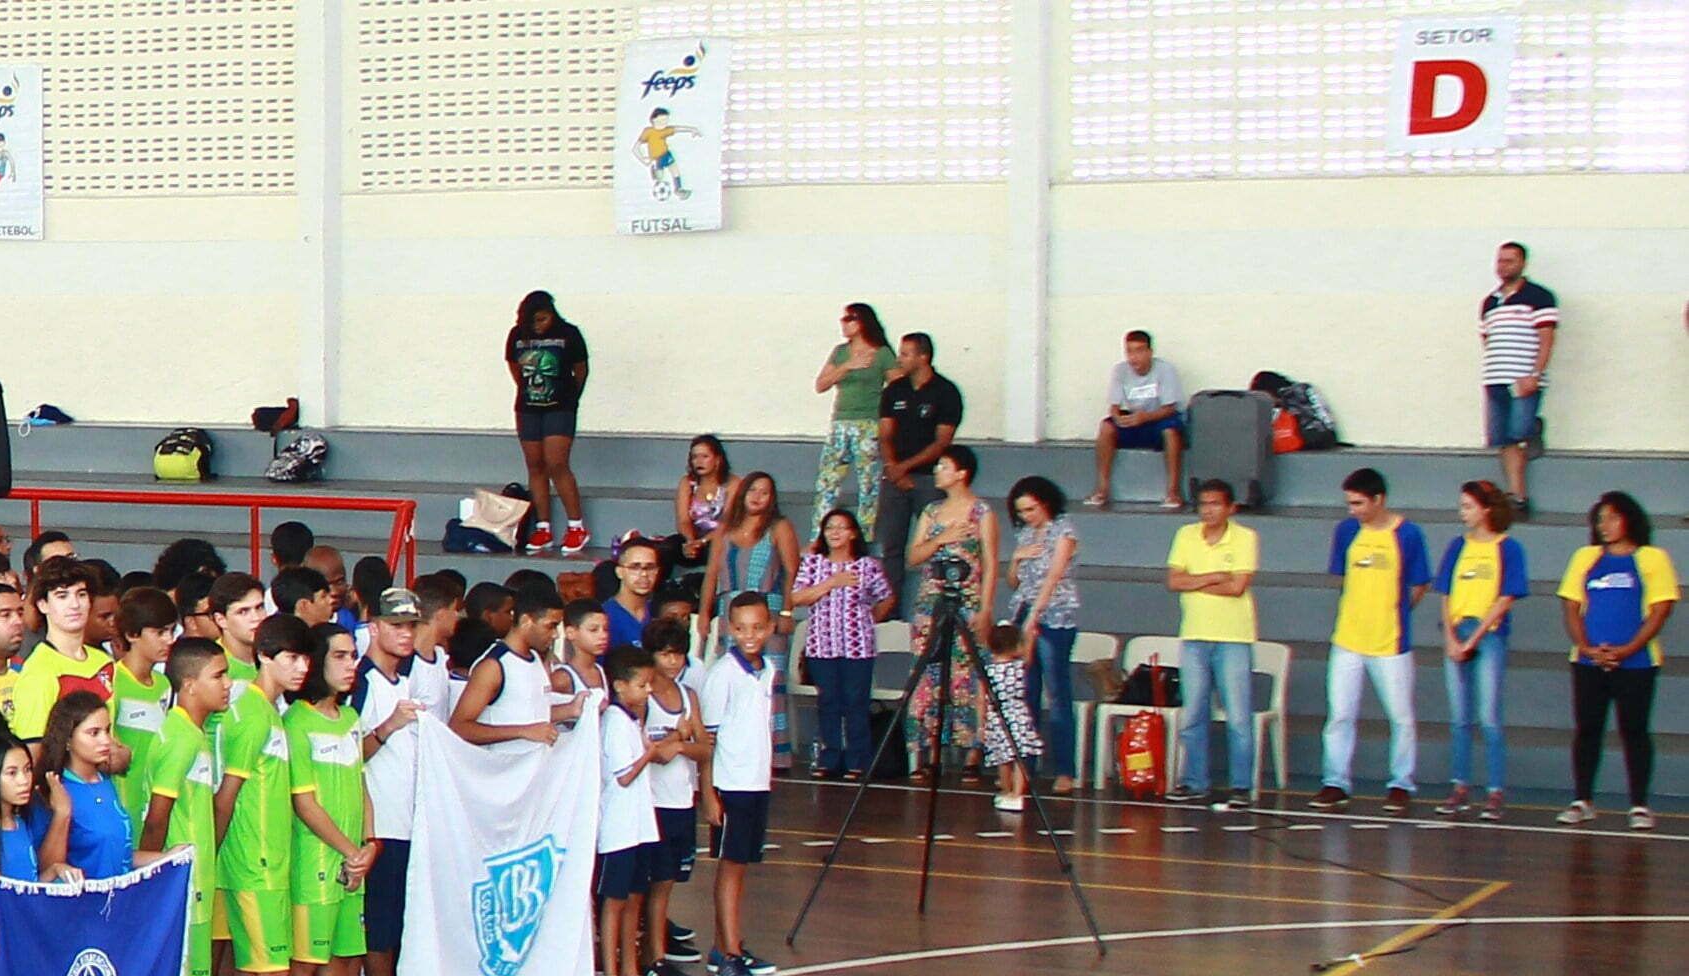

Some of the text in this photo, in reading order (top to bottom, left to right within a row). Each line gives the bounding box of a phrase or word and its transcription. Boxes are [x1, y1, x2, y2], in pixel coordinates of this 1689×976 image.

[1415, 28, 1492, 45] SETOR
[641, 70, 696, 100] feeps
[1408, 60, 1488, 135] D
[631, 218, 693, 233] FUTSAL
